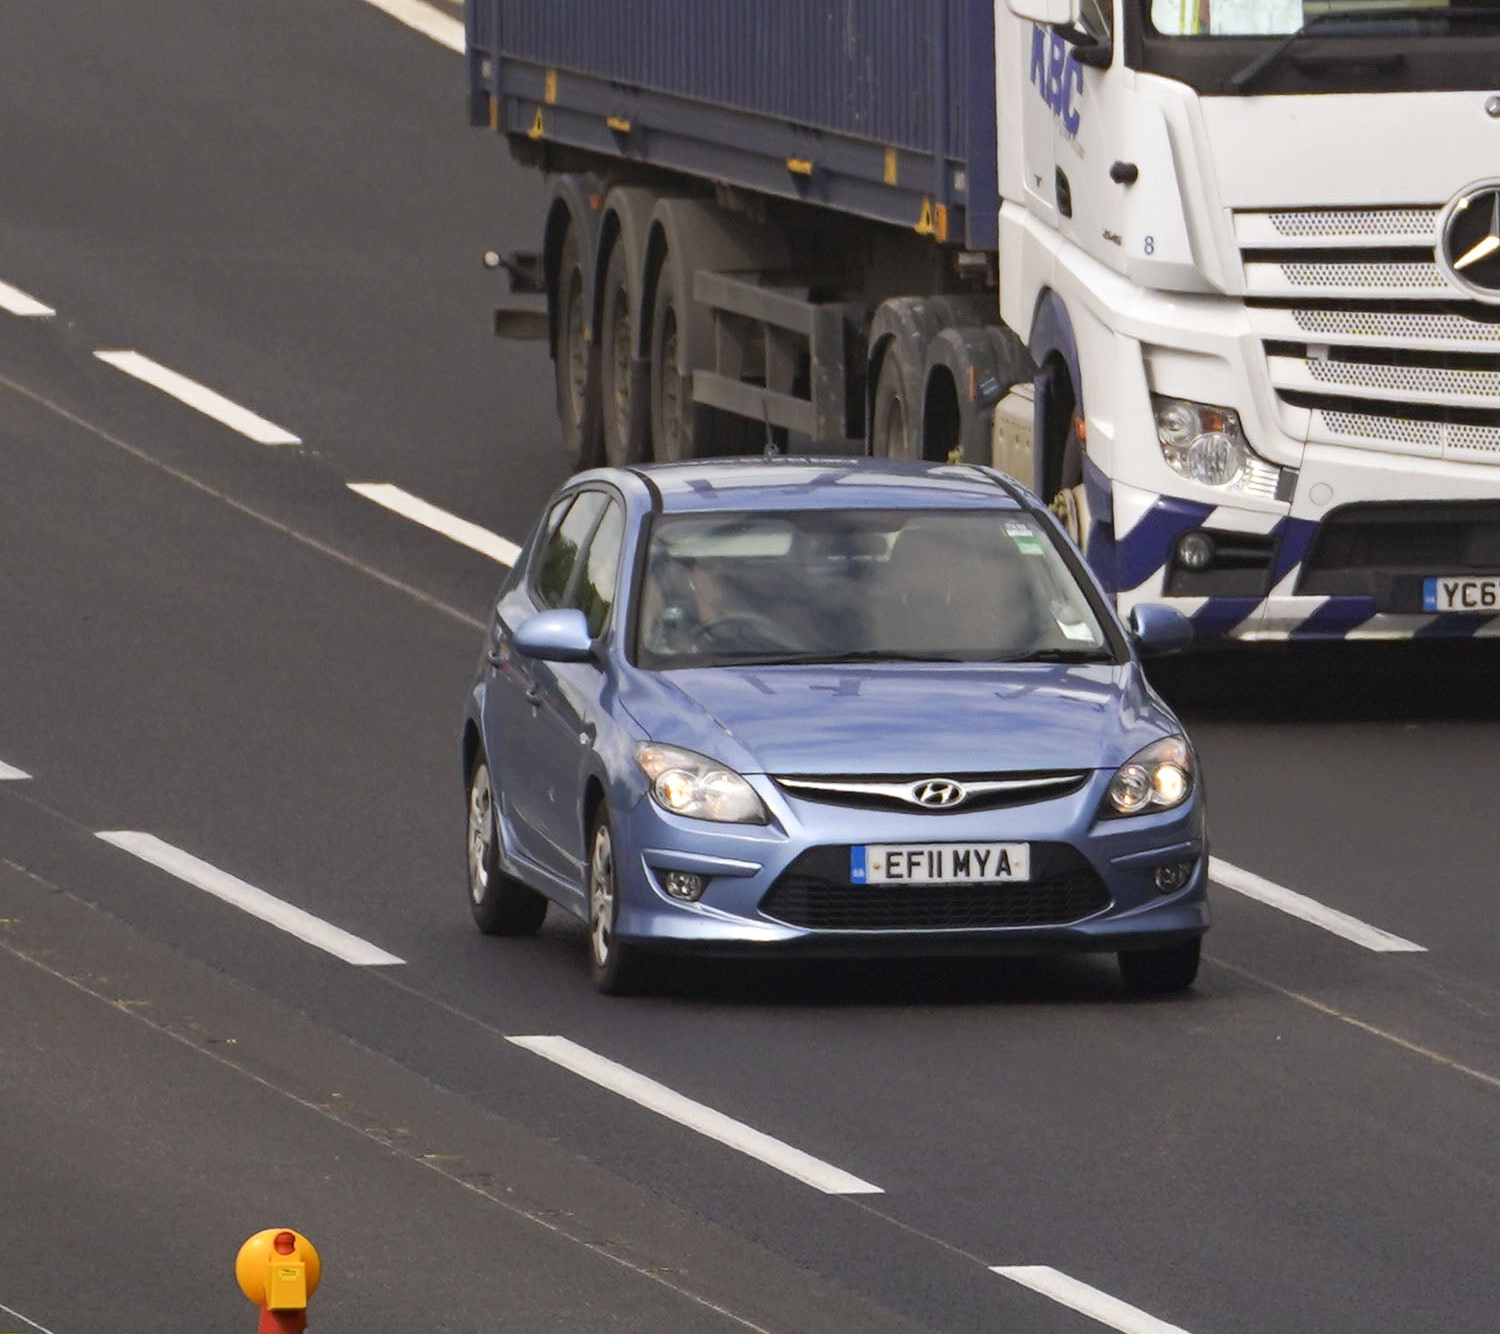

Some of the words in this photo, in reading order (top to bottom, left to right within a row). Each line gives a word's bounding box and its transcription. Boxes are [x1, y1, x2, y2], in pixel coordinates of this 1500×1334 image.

[1030, 21, 1083, 137] KBC
[1143, 234, 1155, 256] 8
[952, 849, 1013, 877] MYA
